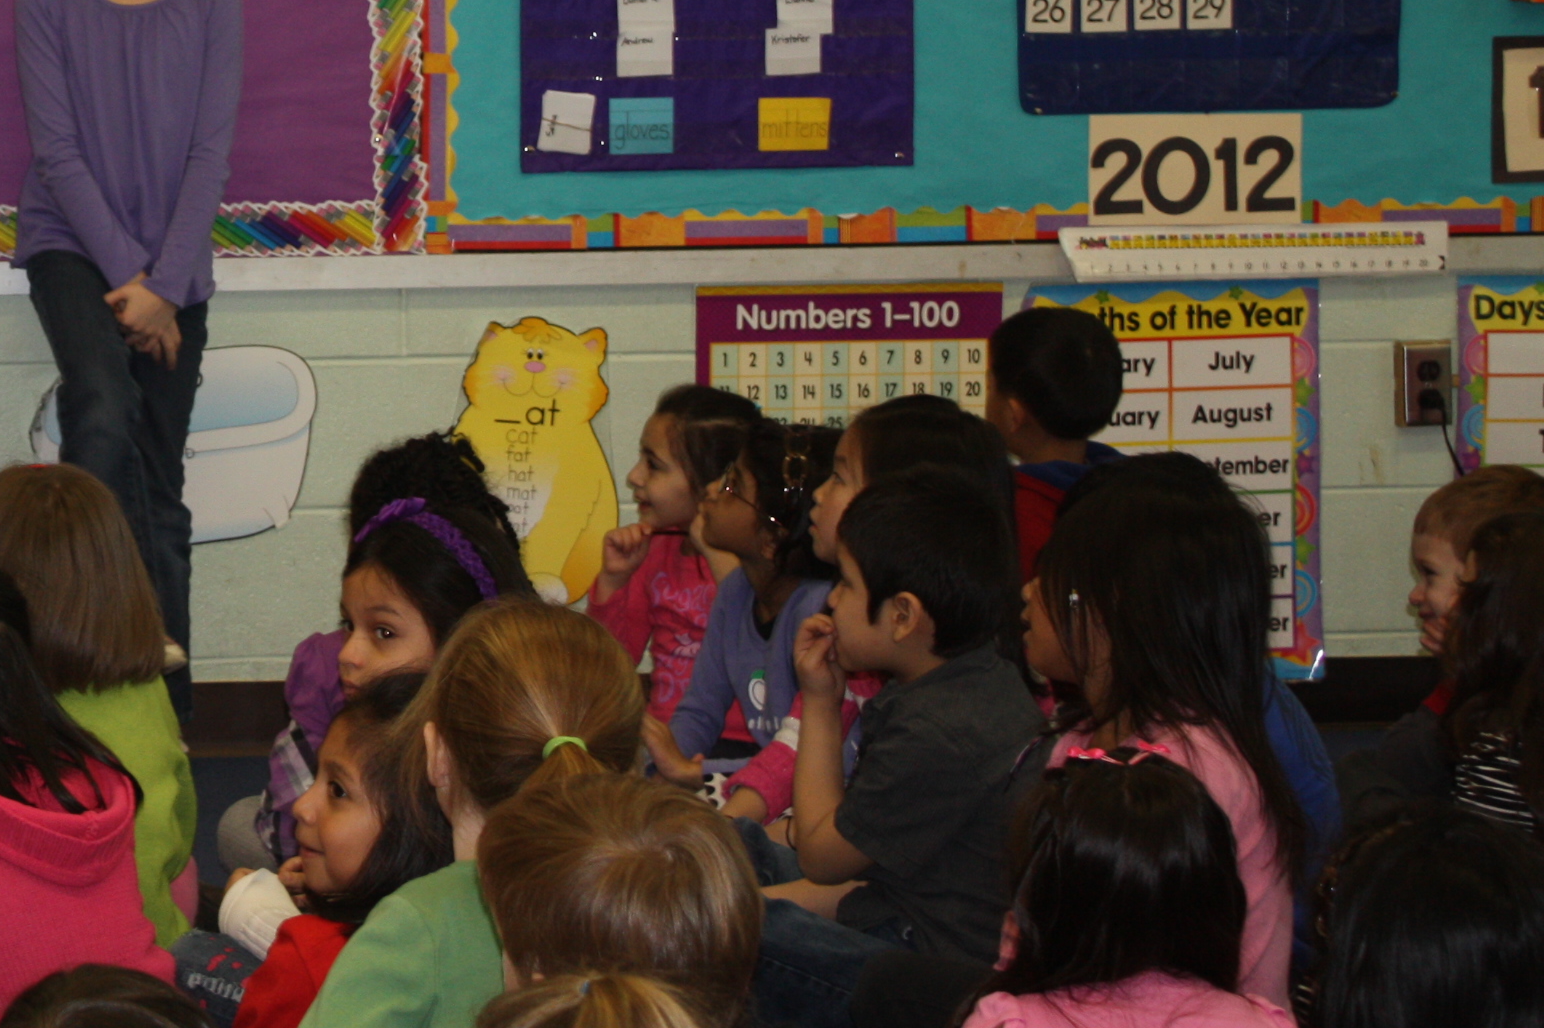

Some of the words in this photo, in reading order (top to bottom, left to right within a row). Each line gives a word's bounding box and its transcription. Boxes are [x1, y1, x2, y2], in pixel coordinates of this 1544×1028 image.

[621, 37, 654, 47] Andrew
[614, 111, 669, 149] gloves
[761, 109, 827, 138] mittens
[1089, 135, 1297, 216] 2012
[735, 301, 873, 331] Numbers
[1149, 305, 1177, 331] of
[1186, 304, 1233, 330] the
[1238, 302, 1305, 328] Year
[1474, 294, 1544, 326] Days
[749, 352, 757, 368] 2
[776, 351, 785, 367] 3
[804, 351, 813, 366] 4
[831, 350, 840, 366] 5
[859, 350, 867, 366] 6
[886, 350, 895, 365] 7
[914, 349, 923, 365] 8
[941, 348, 950, 364] 9
[967, 348, 981, 364] 10
[1207, 351, 1255, 374] July
[747, 385, 760, 400] 12
[774, 384, 788, 400] 13
[802, 384, 816, 399] 14
[829, 383, 843, 399] 15
[857, 383, 871, 398] 16
[885, 383, 898, 397] 17
[939, 381, 953, 396] 19
[965, 381, 981, 397] 20
[1191, 403, 1273, 428] August
[505, 427, 538, 445] cat
[506, 445, 531, 462] fat
[508, 465, 534, 482] hat
[506, 485, 537, 501] mat
